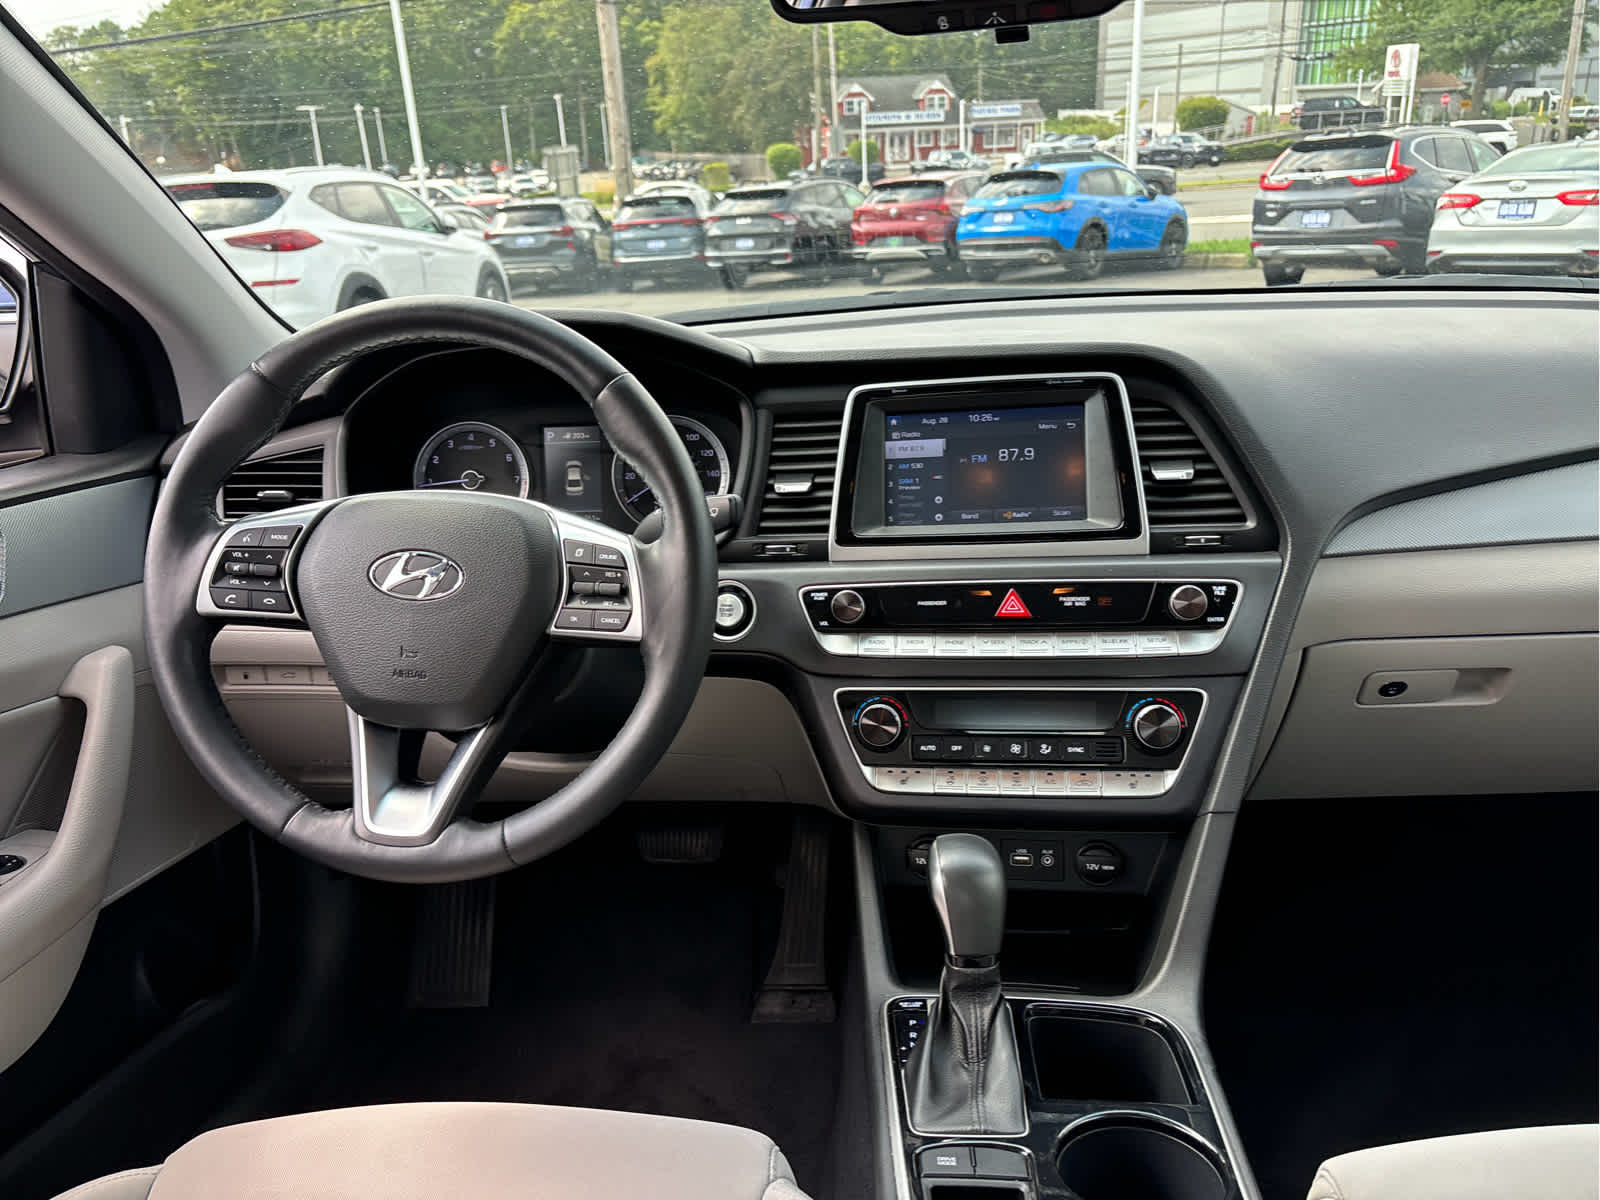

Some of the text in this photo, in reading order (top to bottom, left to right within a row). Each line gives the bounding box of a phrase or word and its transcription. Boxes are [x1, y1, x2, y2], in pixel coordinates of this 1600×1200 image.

[685, 433, 700, 441] 100
[447, 440, 454, 448] 3
[488, 438, 496, 448] 5
[700, 449, 714, 457] 120
[971, 447, 1035, 463] FM 87.9
[432, 455, 440, 464] 2
[505, 453, 512, 462] 6
[624, 472, 635, 480] 20
[960, 512, 979, 520] Band
[1052, 508, 1071, 516] Scan
